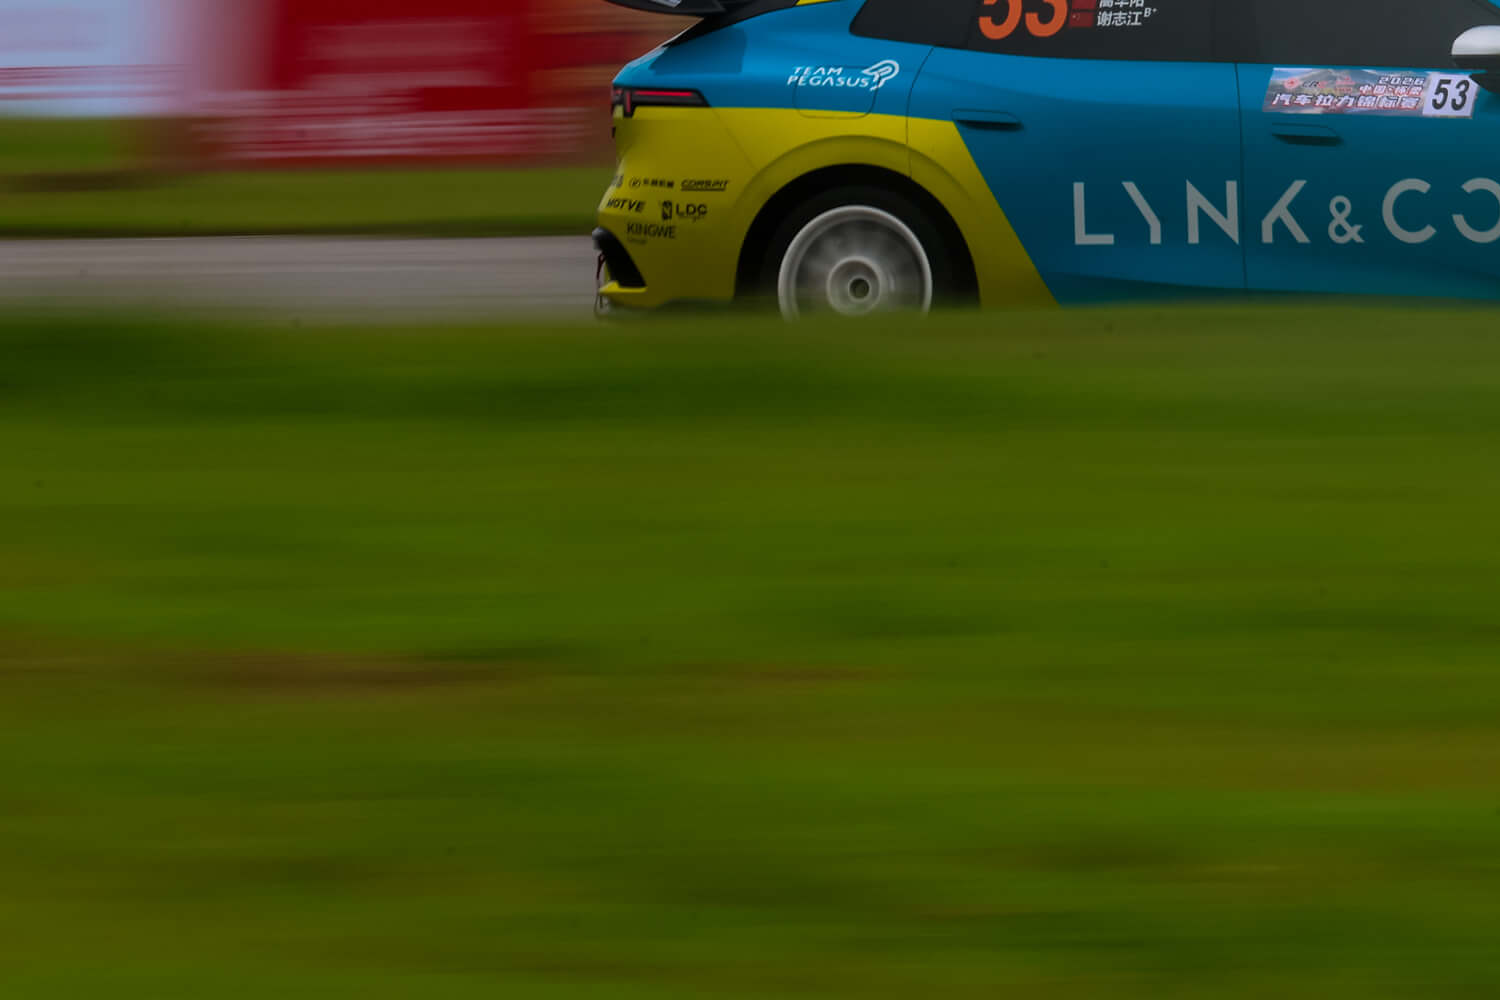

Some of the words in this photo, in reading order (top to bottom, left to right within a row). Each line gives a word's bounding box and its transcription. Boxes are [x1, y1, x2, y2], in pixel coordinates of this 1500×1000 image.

[1096, 10, 1142, 27] 谢志江
[793, 66, 843, 76] TEAM
[786, 75, 869, 88] PEGASUS
[1431, 79, 1471, 111] 53
[676, 204, 708, 216] LDC
[627, 223, 677, 239] KINGWE
